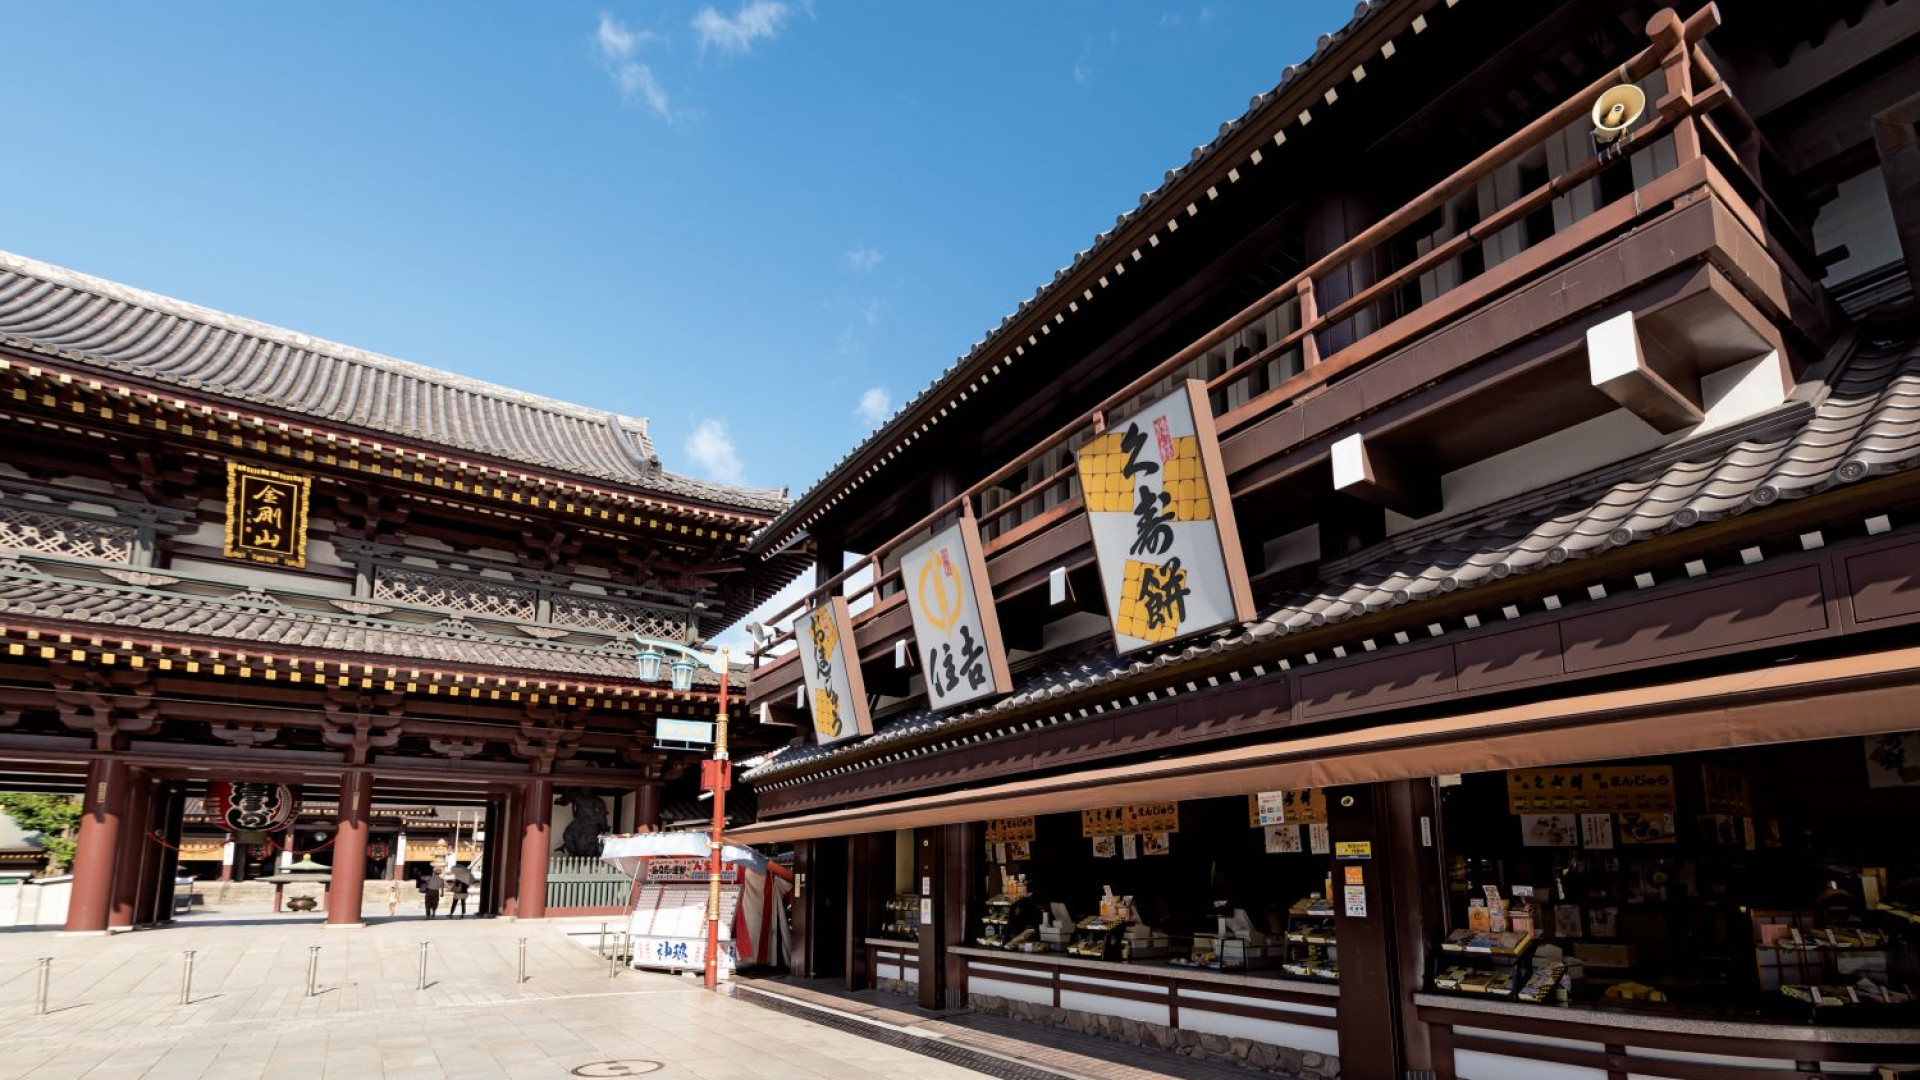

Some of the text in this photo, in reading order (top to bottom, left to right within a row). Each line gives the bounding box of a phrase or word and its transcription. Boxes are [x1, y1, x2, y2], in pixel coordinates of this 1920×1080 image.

[252, 484, 286, 548] 金剛山
[1120, 421, 1191, 630] 久寿餅
[929, 624, 987, 698] 住吉
[1610, 774, 1670, 788] まんじゅう
